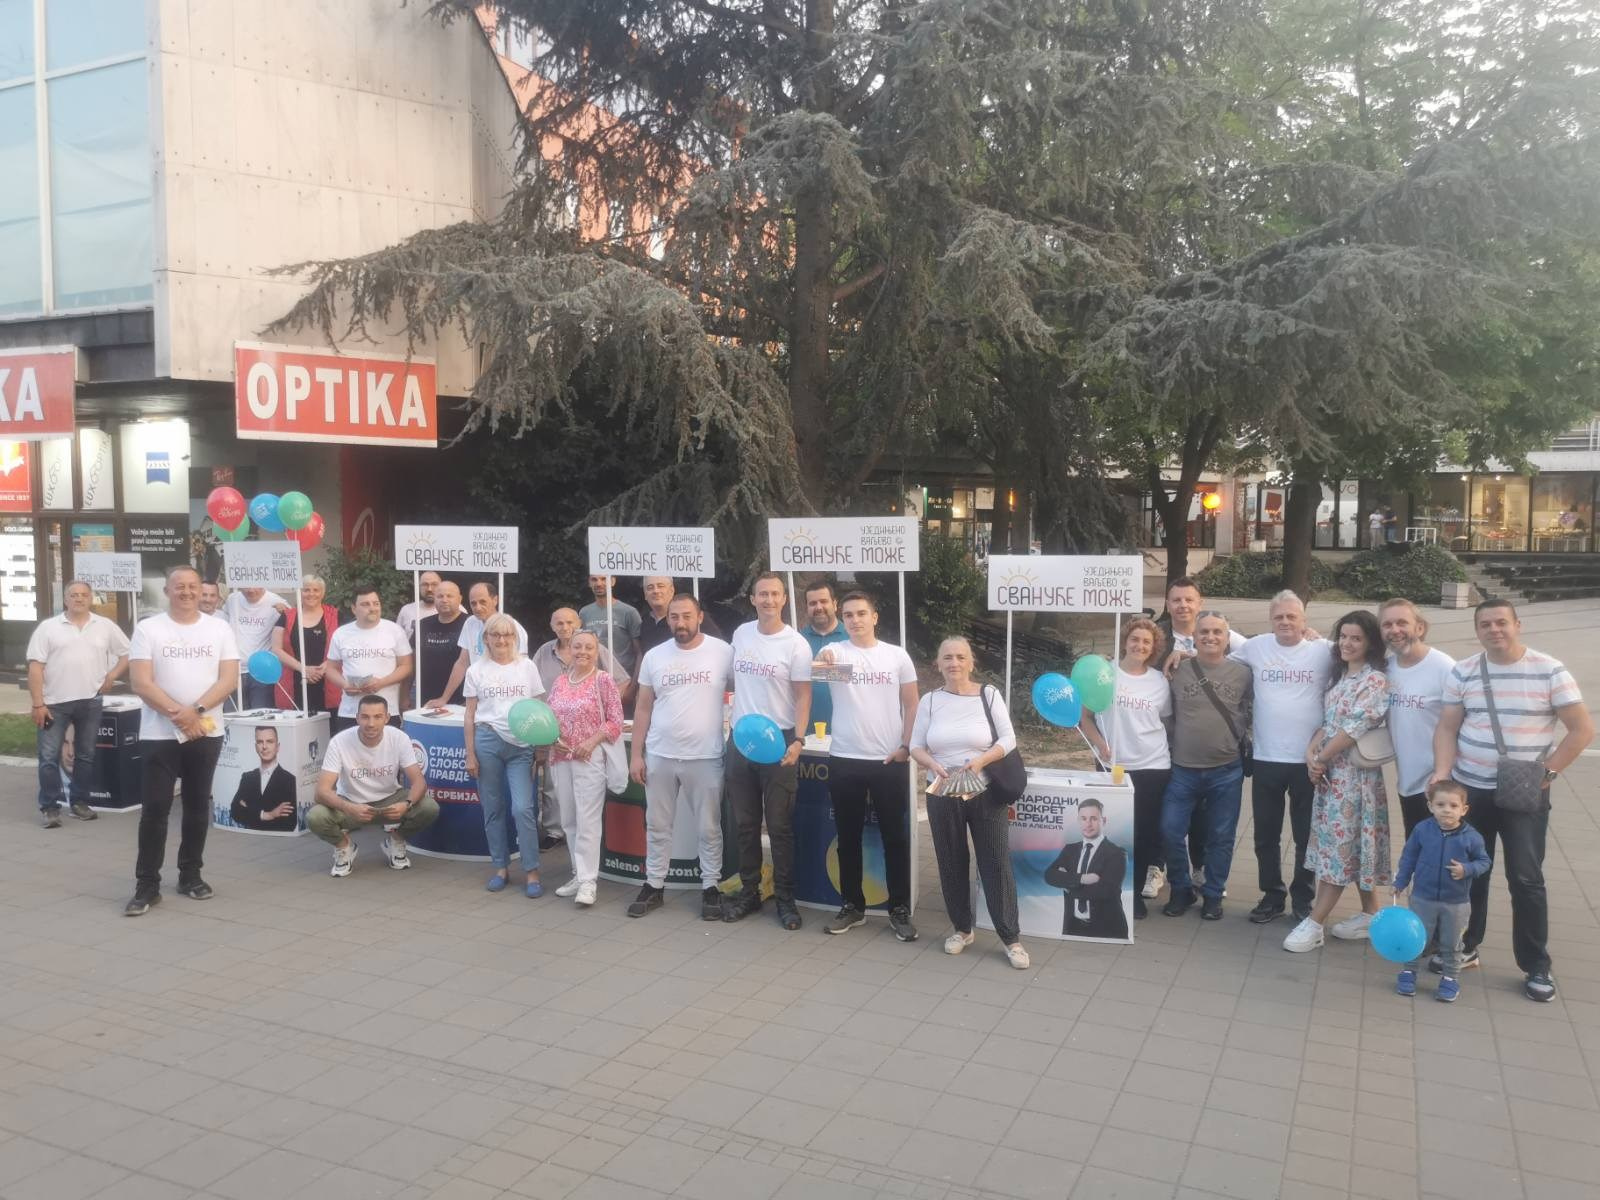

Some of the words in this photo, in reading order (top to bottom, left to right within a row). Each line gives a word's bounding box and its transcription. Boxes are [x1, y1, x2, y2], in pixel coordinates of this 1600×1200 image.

[247, 362, 427, 427] OPTIKA
[860, 526, 905, 535] УЈЕДИЊЕНО
[406, 549, 464, 566] СВАНУЋЕ
[473, 552, 508, 567] МОЖЕ
[782, 546, 853, 564] СВАНУЋЕ
[861, 547, 906, 564] МОЖЕ
[599, 552, 657, 571] СВАНУЋЕ
[666, 555, 703, 572] МОЖЕ
[229, 567, 270, 581] СВАНУЋЕ
[273, 568, 298, 581] МОЖЕ
[1083, 567, 1133, 576] УЈЕДИЊЕНО
[1083, 578, 1117, 587] ВАЉЕВО
[998, 586, 1075, 606] СВАНУЋЕ
[1083, 589, 1132, 607] МОЖЕ
[163, 645, 212, 658] СВАНУЋЕ
[735, 660, 777, 677] СВАНУЋЕ
[662, 671, 711, 686] СВАНУЋЕ
[851, 671, 893, 684] ВАНУЋЕ
[1262, 670, 1314, 684] СВАНУЋЕ
[483, 686, 527, 698] СВАНУЋЕ
[429, 758, 467, 769] СЛОБО
[429, 769, 470, 782] ПРАВДЕ
[437, 791, 479, 801] СРБИЈА
[1017, 795, 1079, 805] НАРОДНИ
[1017, 803, 1065, 814] ПОКРЕТ
[1017, 813, 1063, 824] СРБИЈЕ
